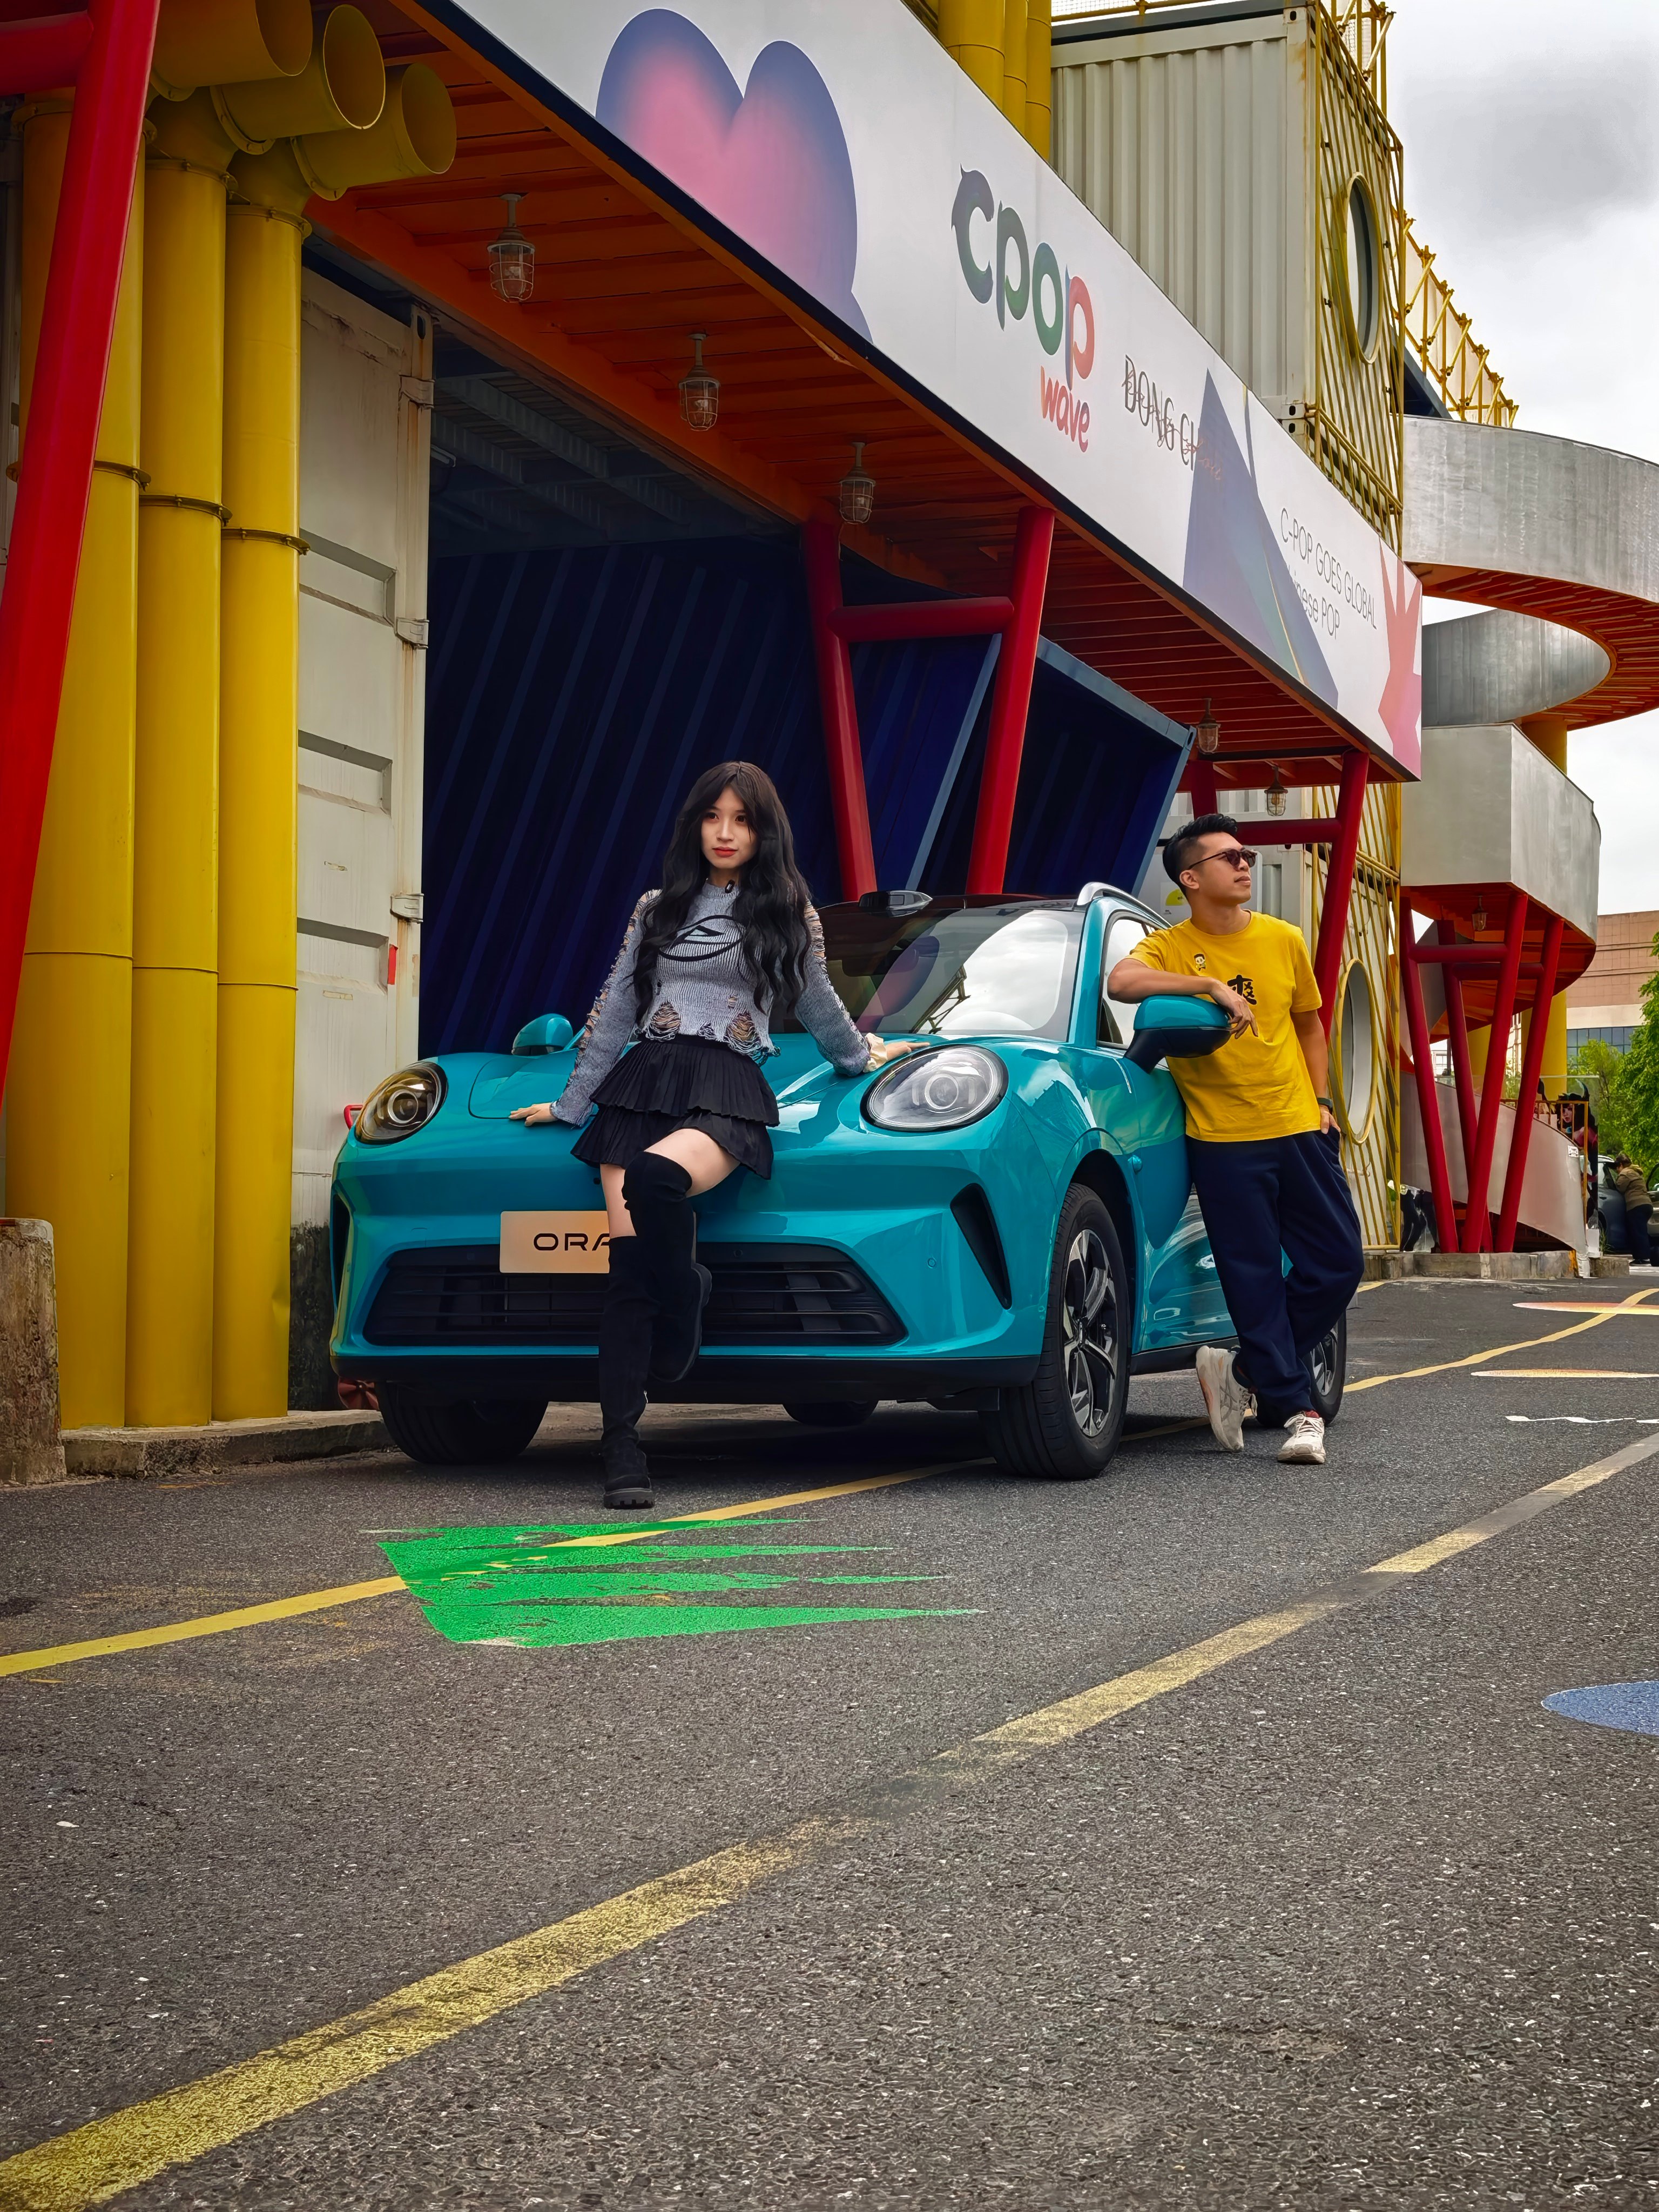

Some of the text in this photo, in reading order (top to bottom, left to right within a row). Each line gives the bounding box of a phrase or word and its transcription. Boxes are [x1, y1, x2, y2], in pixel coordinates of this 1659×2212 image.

[1040, 366, 1090, 453] wave
[1280, 507, 1377, 630] C-POP GOES GLOBAL
[1321, 596, 1340, 640] POP
